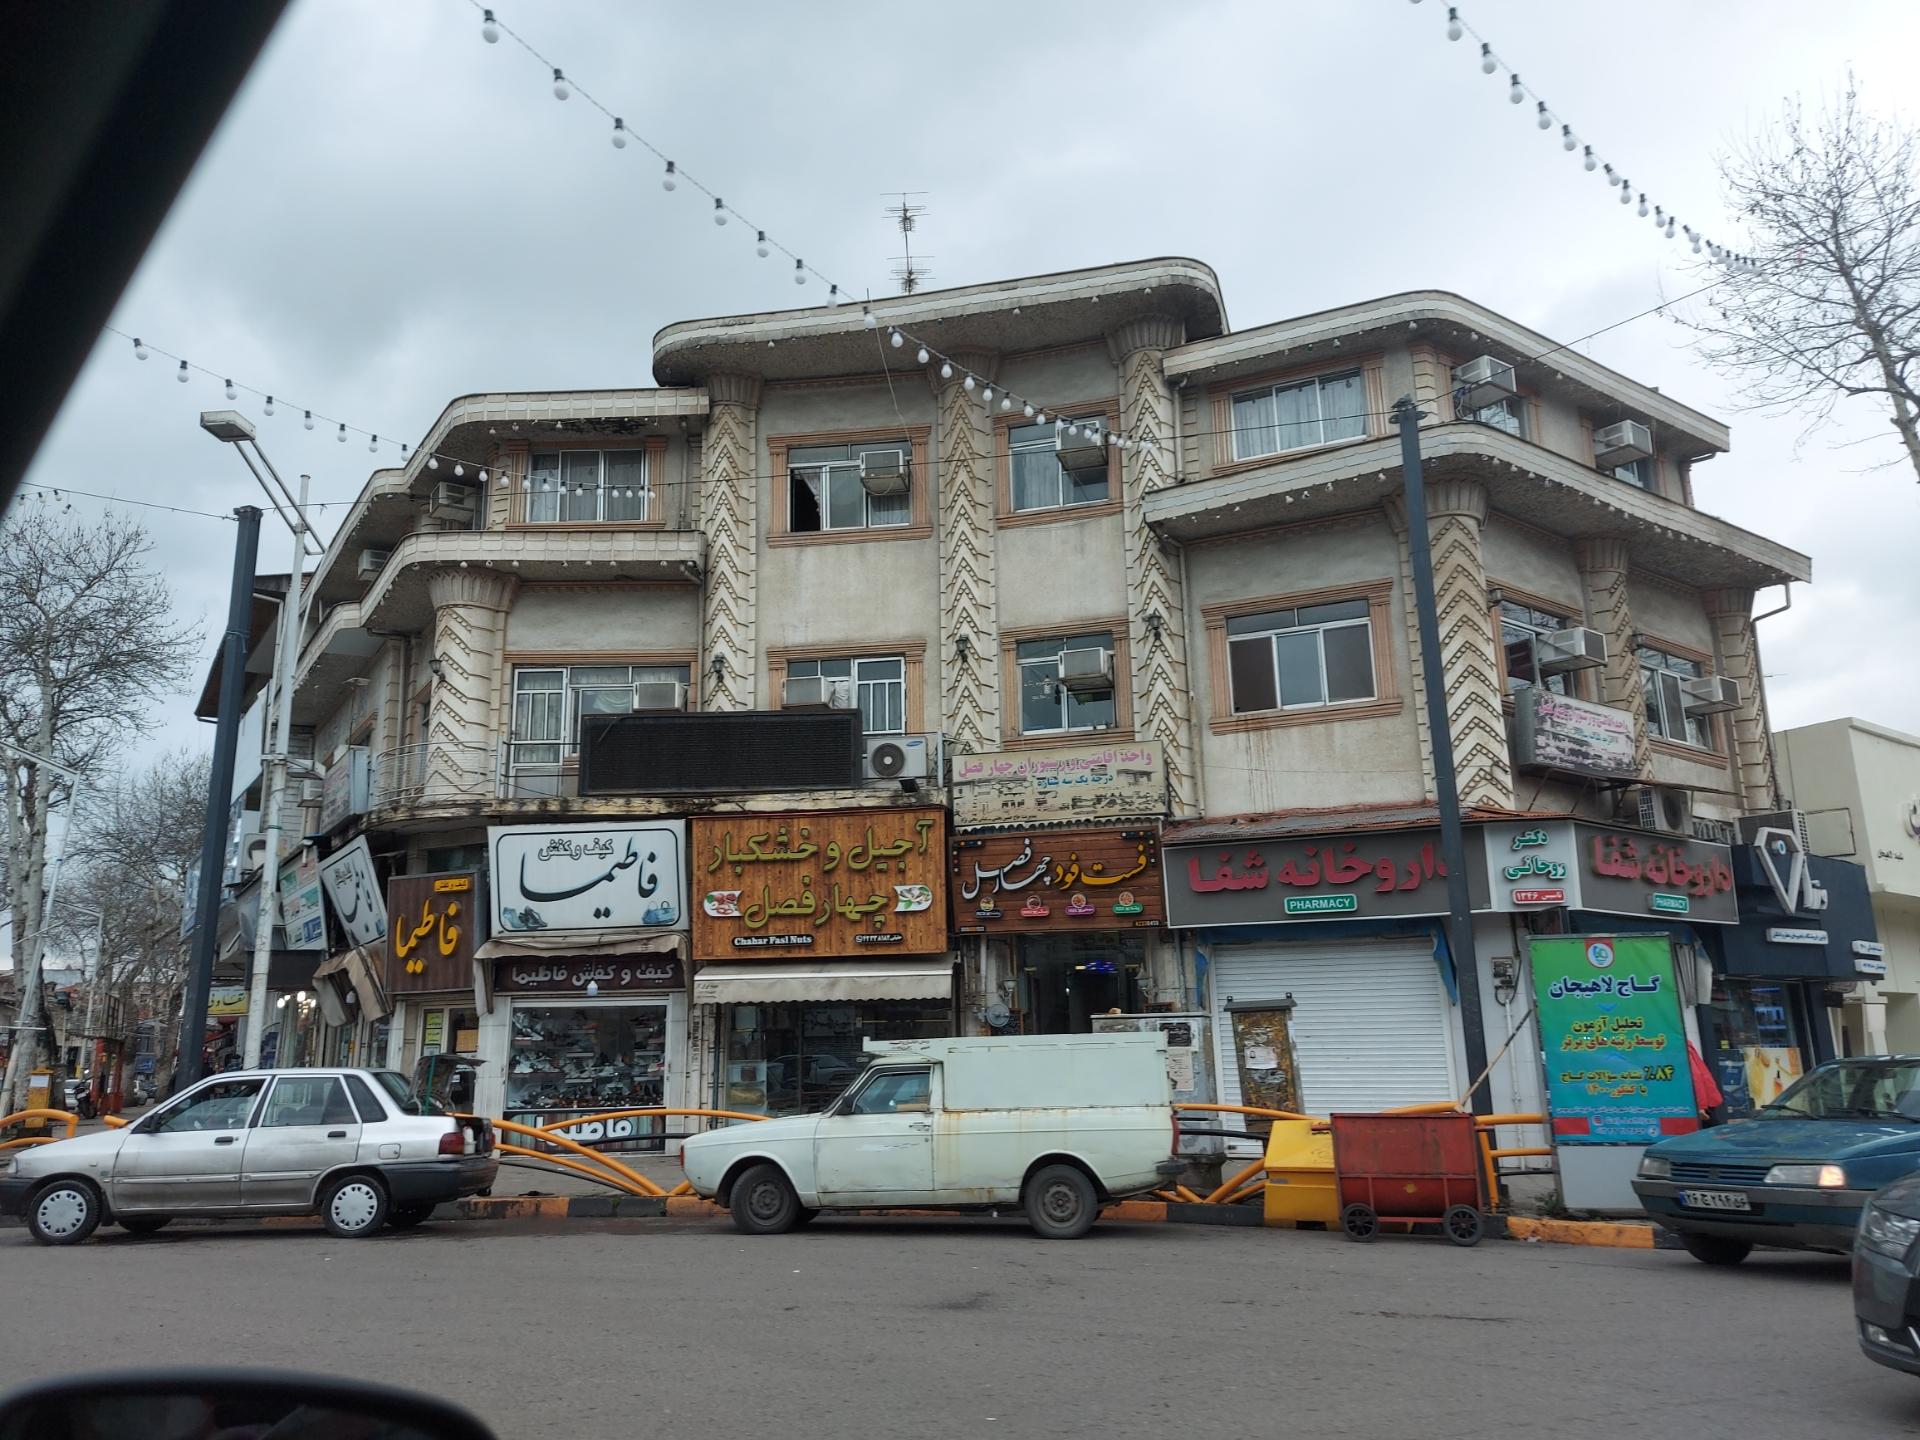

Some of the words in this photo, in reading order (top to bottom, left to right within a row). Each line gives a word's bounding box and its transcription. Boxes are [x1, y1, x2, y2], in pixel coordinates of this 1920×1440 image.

[537, 838, 572, 861] کفش
[583, 837, 614, 859] کیف
[847, 818, 933, 871] آجیل
[1512, 828, 1549, 850] دکتر
[570, 844, 581, 860] و
[708, 826, 819, 876] خشکبار
[823, 839, 841, 871] و
[1592, 834, 1641, 879] شفا
[1054, 851, 1079, 890] فود
[1081, 843, 1147, 885] فست
[1187, 848, 1270, 893] شفا
[1505, 855, 1567, 879] روحانی
[519, 835, 658, 919] فاطیما
[744, 875, 816, 928] فصل
[814, 882, 889, 928] چهار
[1289, 897, 1351, 910] PHARMACY
[395, 897, 461, 974] فاطیما
[734, 936, 768, 947] Chahar
[790, 934, 812, 944] Nuts
[511, 964, 567, 986] فاطیما
[572, 962, 617, 987] کفش
[620, 966, 631, 985] و
[636, 962, 675, 983] کیف
[1549, 975, 1613, 998] لاهیجان
[1617, 975, 1660, 997] گاج
[1573, 1017, 1607, 1033] آزمون
[1611, 1018, 1643, 1032] تحلیل
[1635, 1034, 1665, 1049] توسط
